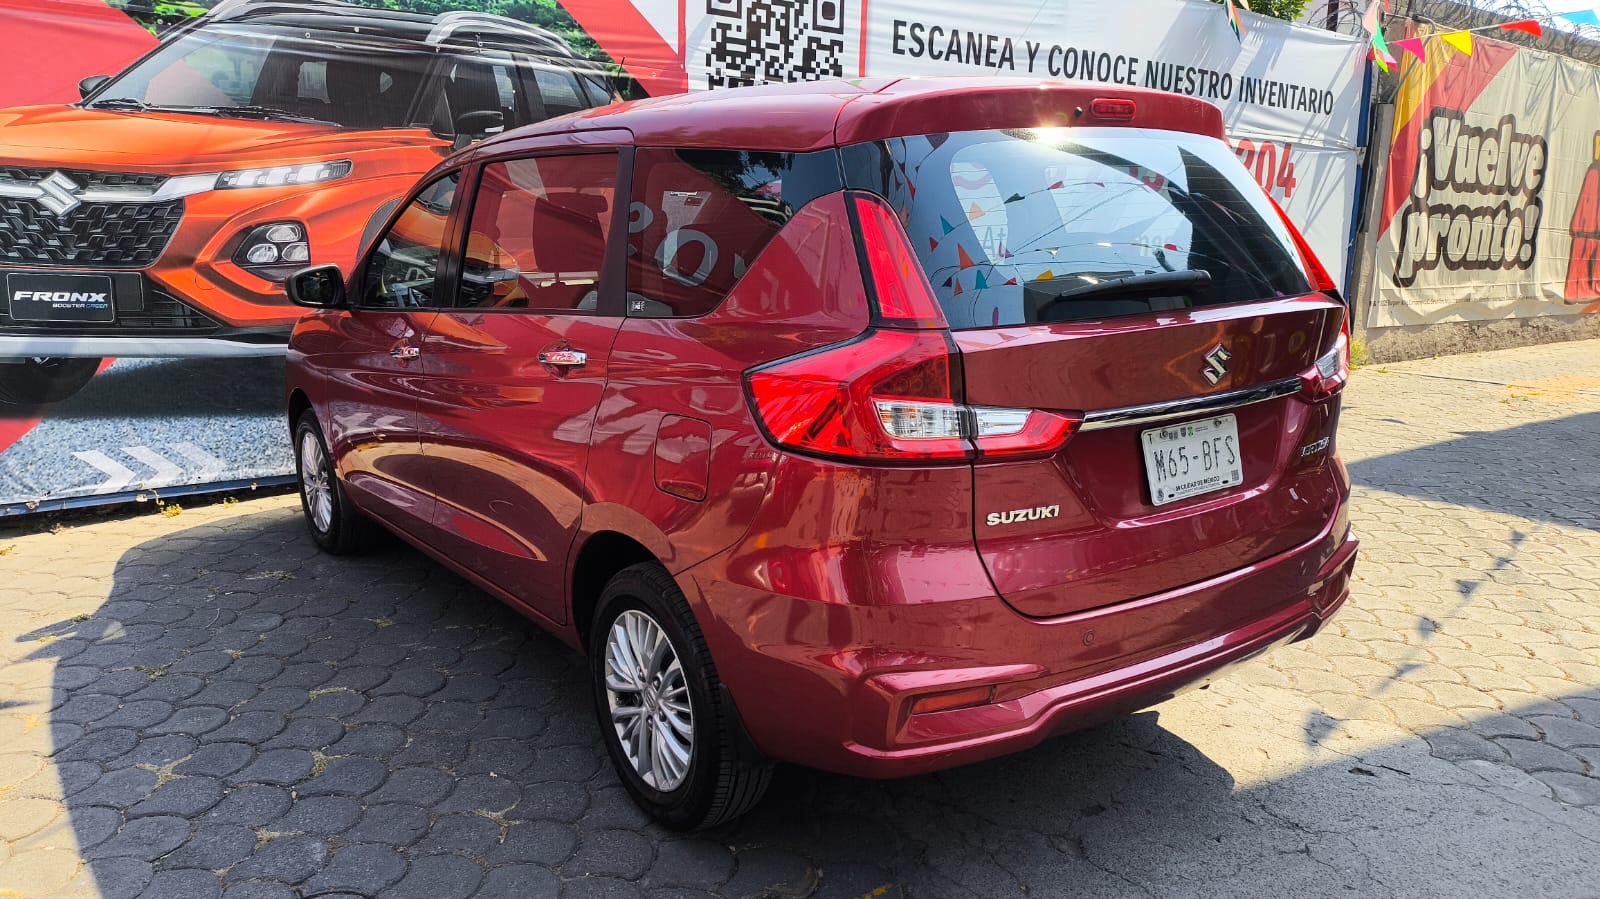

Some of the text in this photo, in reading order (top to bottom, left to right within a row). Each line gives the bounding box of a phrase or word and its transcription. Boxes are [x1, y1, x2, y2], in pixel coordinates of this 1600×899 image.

[892, 19, 1334, 116] ESCANEA Y CONOCE NUESTRO INVENTARIO
[1411, 107, 1548, 201] ¡Vuelve
[1394, 197, 1543, 287] pronto!
[14, 291, 107, 302] FRONX
[1153, 435, 1236, 482] M65-BFS
[986, 504, 1060, 526] SUZUKI
